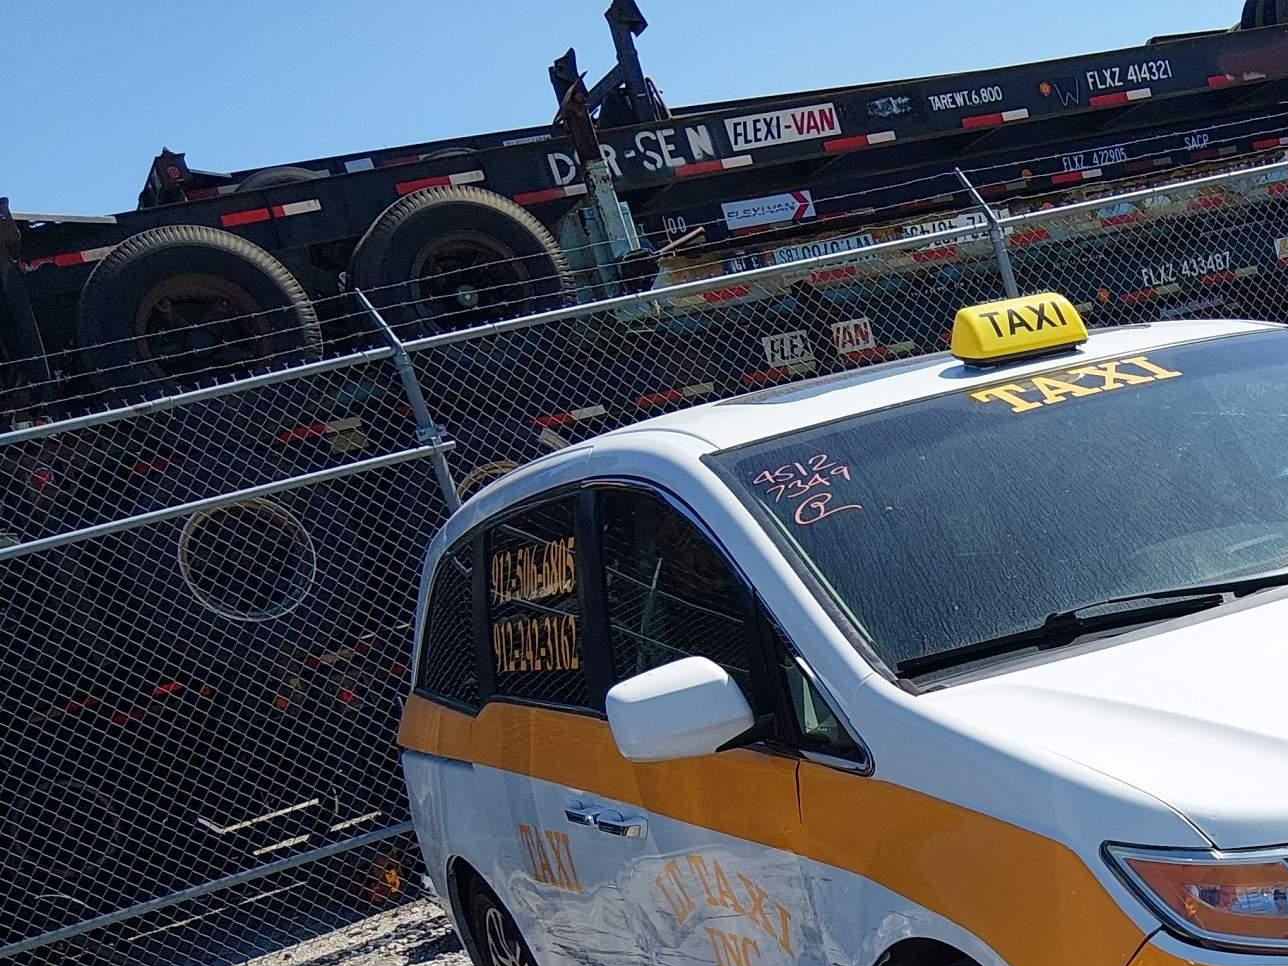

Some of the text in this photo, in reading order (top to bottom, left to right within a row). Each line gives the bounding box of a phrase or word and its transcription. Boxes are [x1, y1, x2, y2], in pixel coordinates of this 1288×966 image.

[1085, 59, 1173, 91] FLXZ 414321
[732, 107, 836, 146] FLEXI-VAN
[1182, 251, 1230, 278] 433487
[979, 301, 1068, 338] TAXI
[970, 356, 1183, 414] TAXI
[518, 823, 585, 895] TAXI
[686, 855, 796, 957] TAXI
